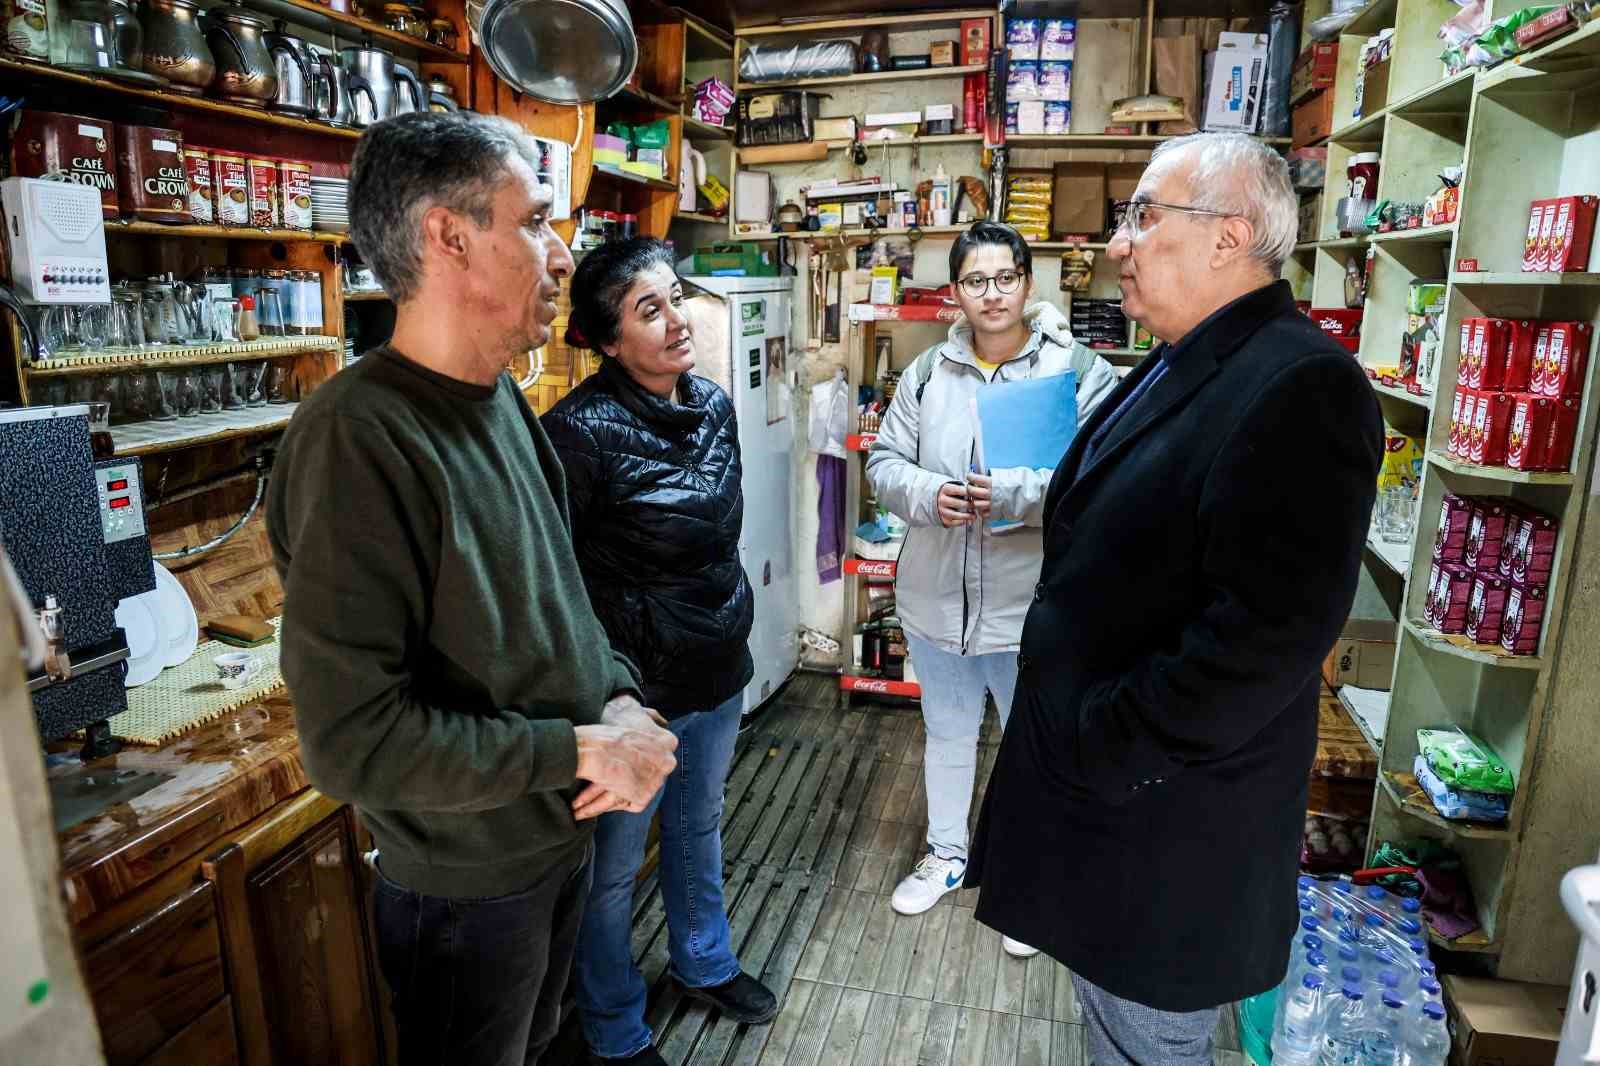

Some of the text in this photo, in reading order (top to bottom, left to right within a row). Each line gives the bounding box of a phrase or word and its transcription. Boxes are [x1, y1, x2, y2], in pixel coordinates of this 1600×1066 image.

[72, 157, 104, 171] CAFÉ
[158, 167, 184, 178] CAFÉ
[857, 562, 892, 576] Coca-Cola
[854, 679, 888, 692] Coca-Cola
